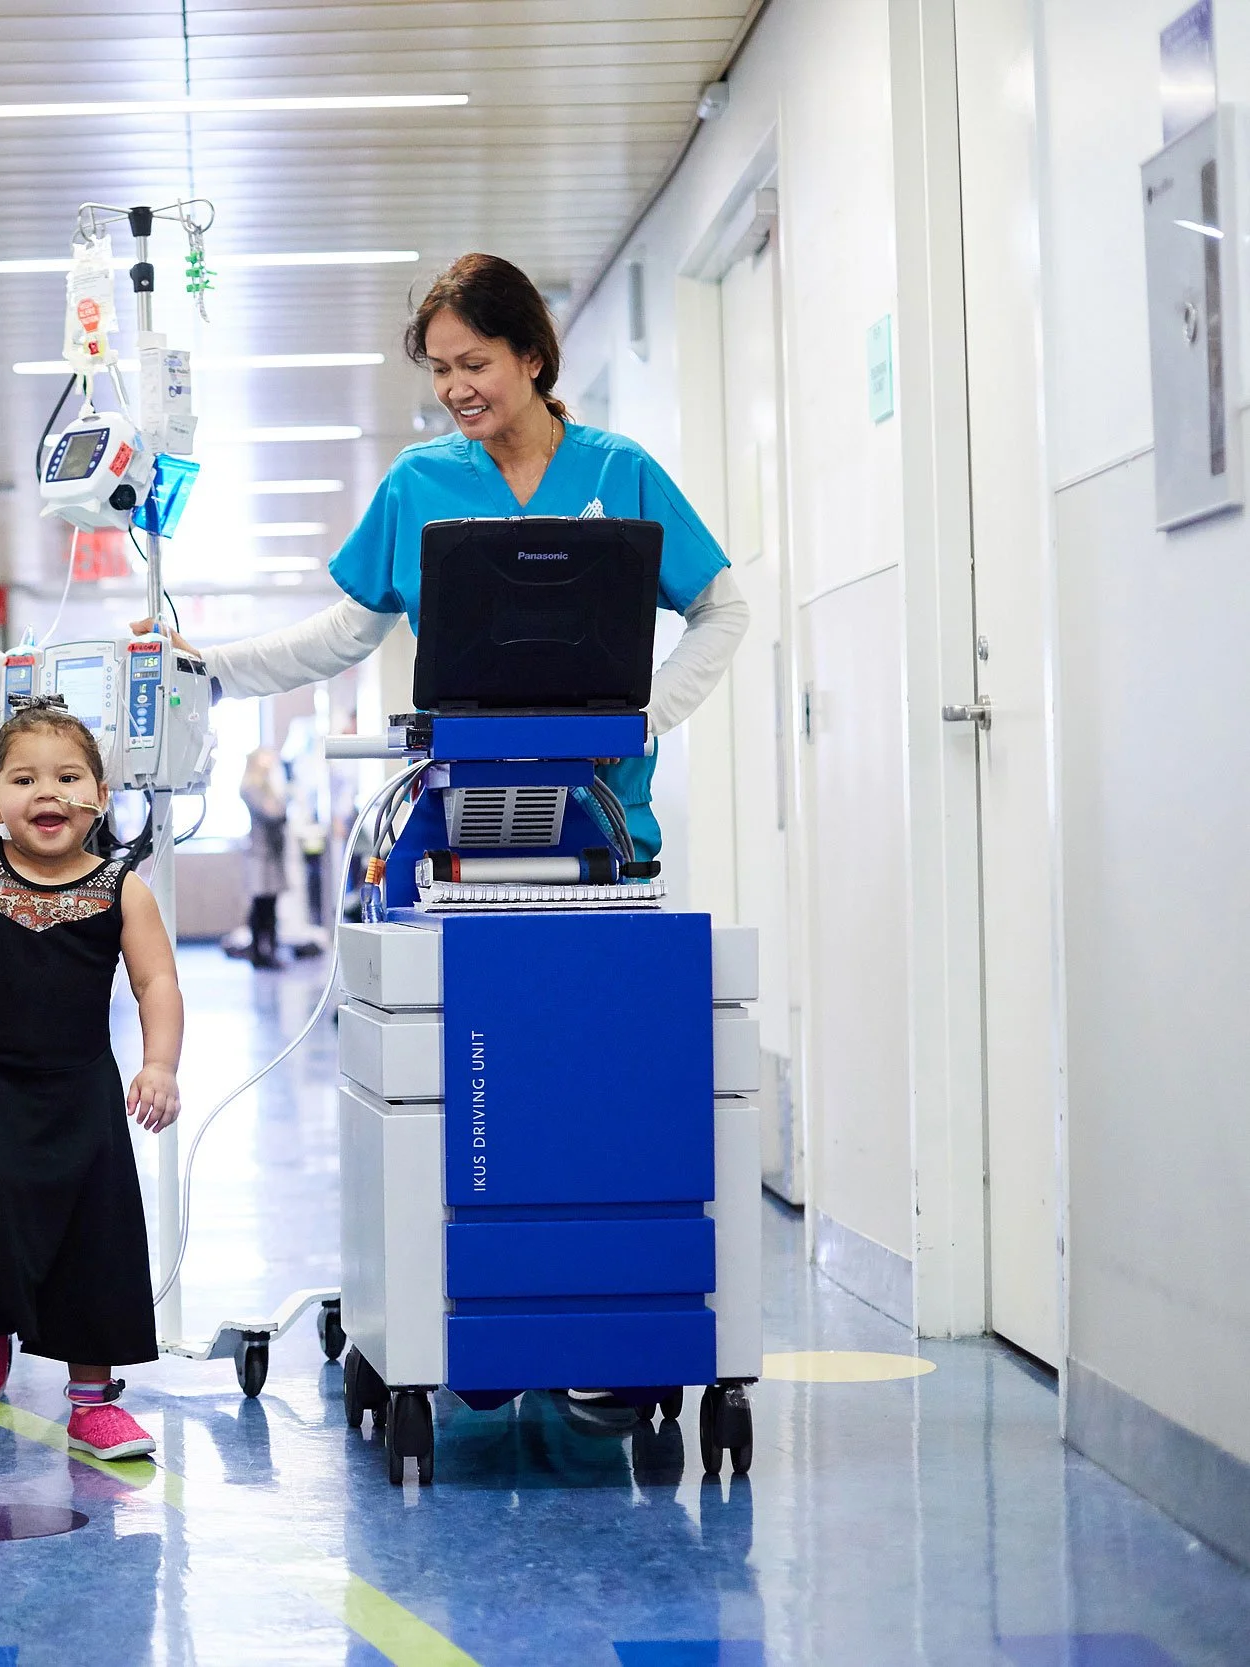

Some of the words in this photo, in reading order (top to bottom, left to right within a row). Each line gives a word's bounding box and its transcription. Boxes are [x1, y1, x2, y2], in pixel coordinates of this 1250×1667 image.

[517, 551, 569, 560] Panasonic
[471, 1030, 485, 1071] UNIT
[472, 1078, 486, 1148] DRIVING
[473, 1155, 487, 1192] IKUS
